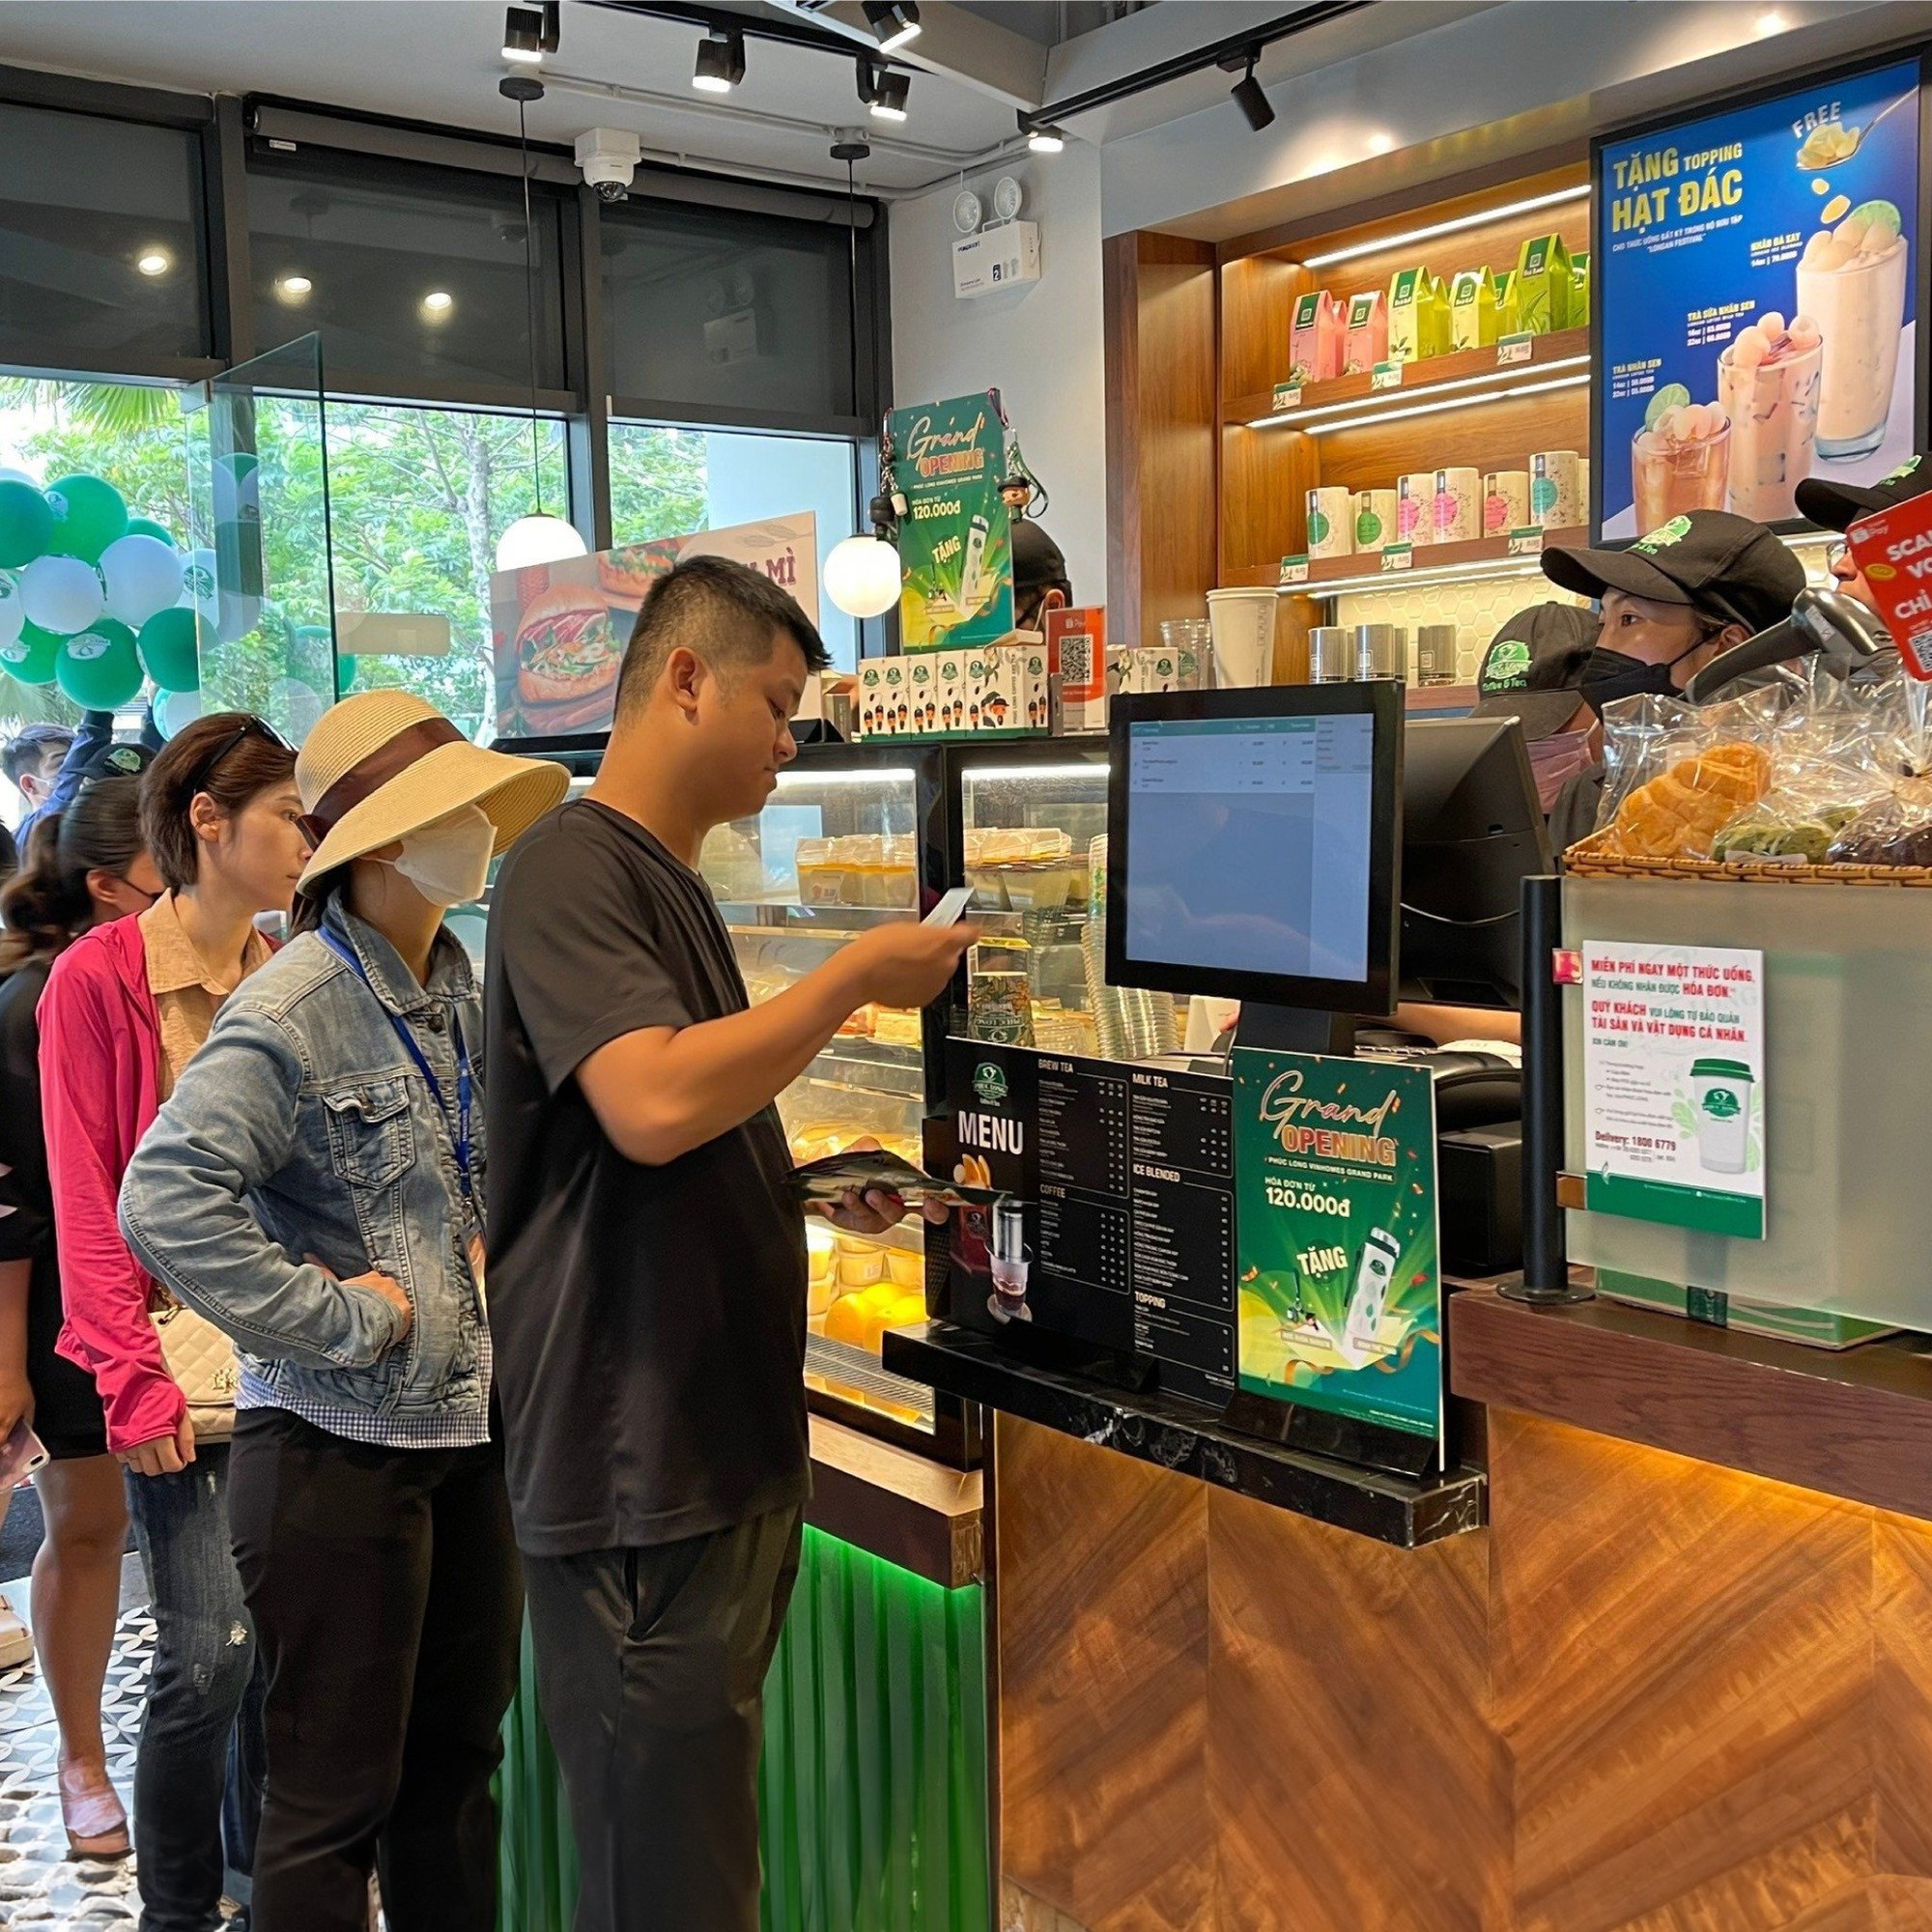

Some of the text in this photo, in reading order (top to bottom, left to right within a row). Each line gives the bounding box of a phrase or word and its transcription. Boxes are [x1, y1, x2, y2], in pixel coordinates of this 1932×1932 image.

[1792, 101, 1841, 139] FREE
[1613, 142, 1743, 191] TẶNG TOPPING
[1612, 167, 1743, 234] HẠT ĐÁC
[906, 412, 982, 471] Grand
[920, 448, 984, 478] OPENING
[913, 499, 961, 520] 120.000đ
[931, 535, 961, 564] TẶNG
[766, 547, 796, 585] MÌ
[1592, 956, 1615, 972] MIỄN
[1619, 959, 1635, 974] PHÍ
[1638, 963, 1664, 976] NGAY
[1667, 962, 1689, 980] MỘT
[1691, 964, 1719, 980] THỨC
[1683, 981, 1704, 996] HÓA
[1613, 1000, 1647, 1015] KHÁCH
[1592, 1016, 1606, 1029] TÀI
[1699, 1024, 1713, 1039] CÁ
[1038, 1059, 1074, 1073] BREW TEA
[1132, 1073, 1169, 1088] MILK TEA
[1260, 1069, 1397, 1139] Grand
[958, 1110, 1023, 1155] MENU
[1281, 1123, 1396, 1167] OPENING
[1632, 1136, 1653, 1148] 1800
[1133, 1163, 1180, 1182] ICE BLENDED
[1268, 1155, 1393, 1181] PHÚC LONG VINHOMES GRAND PARK
[1040, 1183, 1065, 1198] COFFEE
[1264, 1176, 1282, 1186] HÓA
[1283, 1179, 1302, 1189] ĐƠN
[1265, 1186, 1350, 1217] 120.000đ
[1296, 1245, 1349, 1279] TẶNG
[1134, 1291, 1166, 1309] TOPPING
